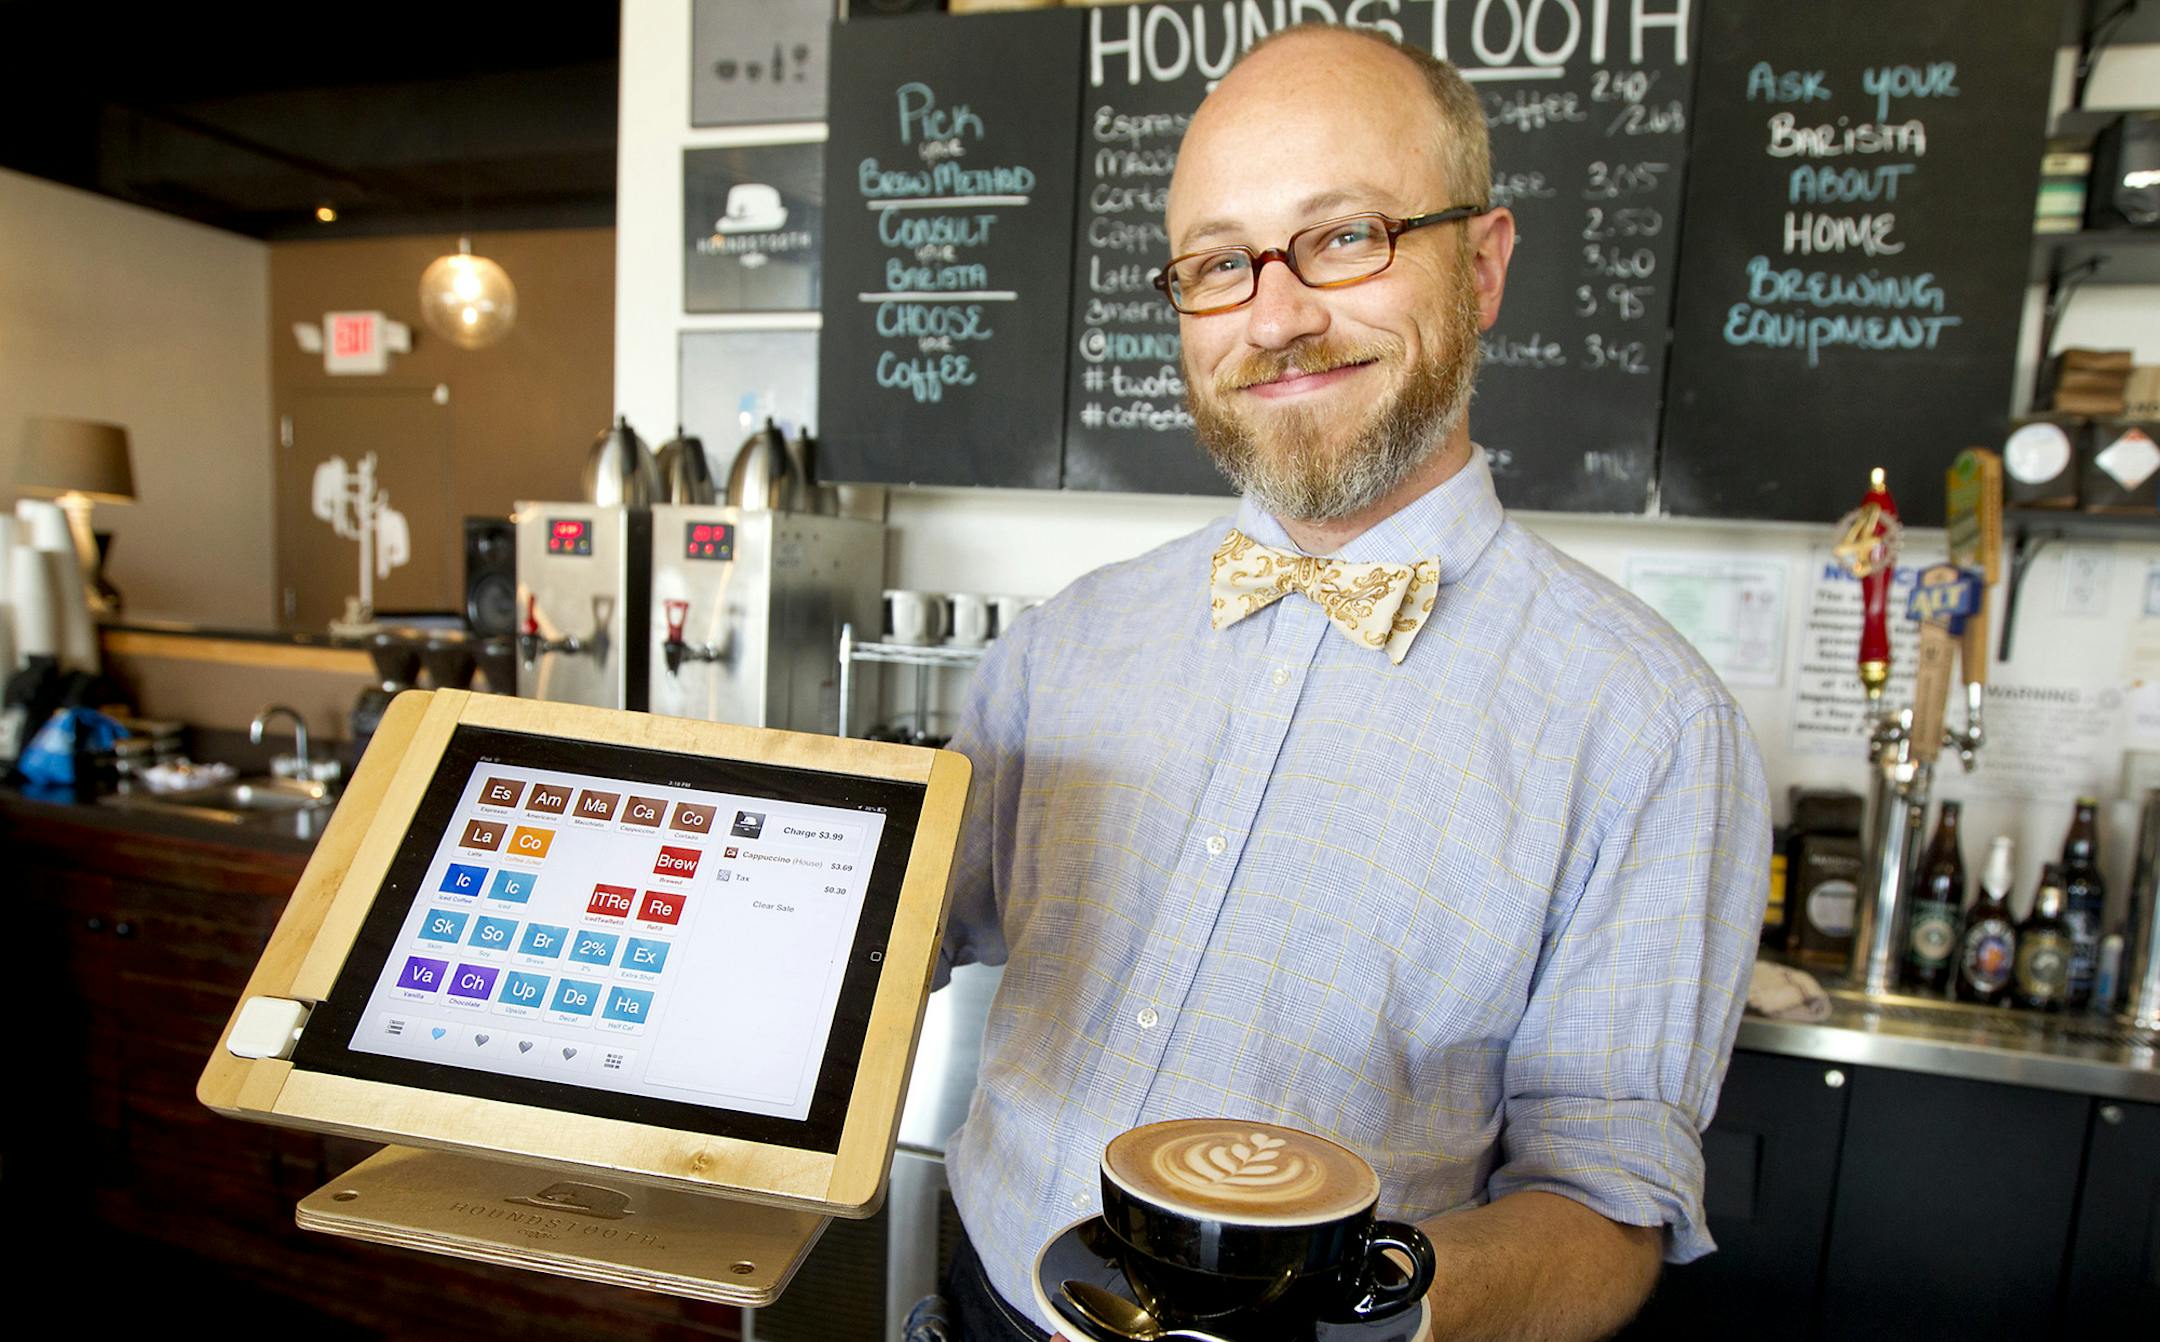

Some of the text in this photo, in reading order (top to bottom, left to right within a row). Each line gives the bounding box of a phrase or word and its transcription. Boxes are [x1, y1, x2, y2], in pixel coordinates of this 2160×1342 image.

[1746, 60, 1832, 101] ASK
[897, 81, 984, 144] Pick
[1766, 111, 1926, 158] BARISTA
[1789, 163, 1916, 205] ABOUT
[878, 204, 998, 248] CONSULT
[1782, 211, 1906, 257] HOME
[886, 257, 988, 292] BARISTA
[1746, 254, 1945, 313] BREWING
[876, 301, 994, 341] CHOOSE
[1723, 302, 1963, 364] EQUIPMENT
[1911, 580, 1968, 619] ALT
[491, 785, 512, 801] Es
[535, 791, 562, 807] Am
[481, 807, 508, 815] Espresso
[584, 798, 608, 814] Ma
[633, 804, 656, 820] Ca
[526, 812, 557, 822] Americano
[575, 818, 604, 828] Macchiato
[681, 811, 704, 827] Co
[472, 827, 493, 843] La
[620, 825, 656, 835] Cappuccino
[674, 832, 699, 841] Cortado
[783, 826, 844, 842] Charge $3.99
[519, 834, 542, 850] Co
[657, 854, 697, 872] Brew
[742, 851, 791, 865] Cappuccino
[792, 856, 823, 869] (House)
[456, 873, 471, 887] Ic
[659, 877, 683, 885] Brewed
[736, 873, 750, 883] Tax
[505, 880, 520, 894] Ic
[824, 885, 846, 896] $0.30
[591, 891, 630, 910] ITRe
[649, 900, 673, 916] Re
[752, 900, 795, 913] Clear Sale
[432, 919, 454, 934] Sk
[482, 926, 504, 941] So
[533, 933, 554, 948] Br
[579, 940, 606, 957] 2%
[633, 947, 656, 964] Ex
[412, 965, 433, 983] Va
[461, 973, 485, 991] Ch
[404, 992, 424, 1000] Vanilla
[512, 980, 536, 1000] Up
[563, 989, 587, 1006] De
[448, 997, 480, 1008] Chocolate
[615, 996, 640, 1014] Ha
[505, 1006, 527, 1016] Upsize
[559, 1014, 578, 1023] Decaf
[450, 1201, 659, 1247] HOUNDSTOOTH
